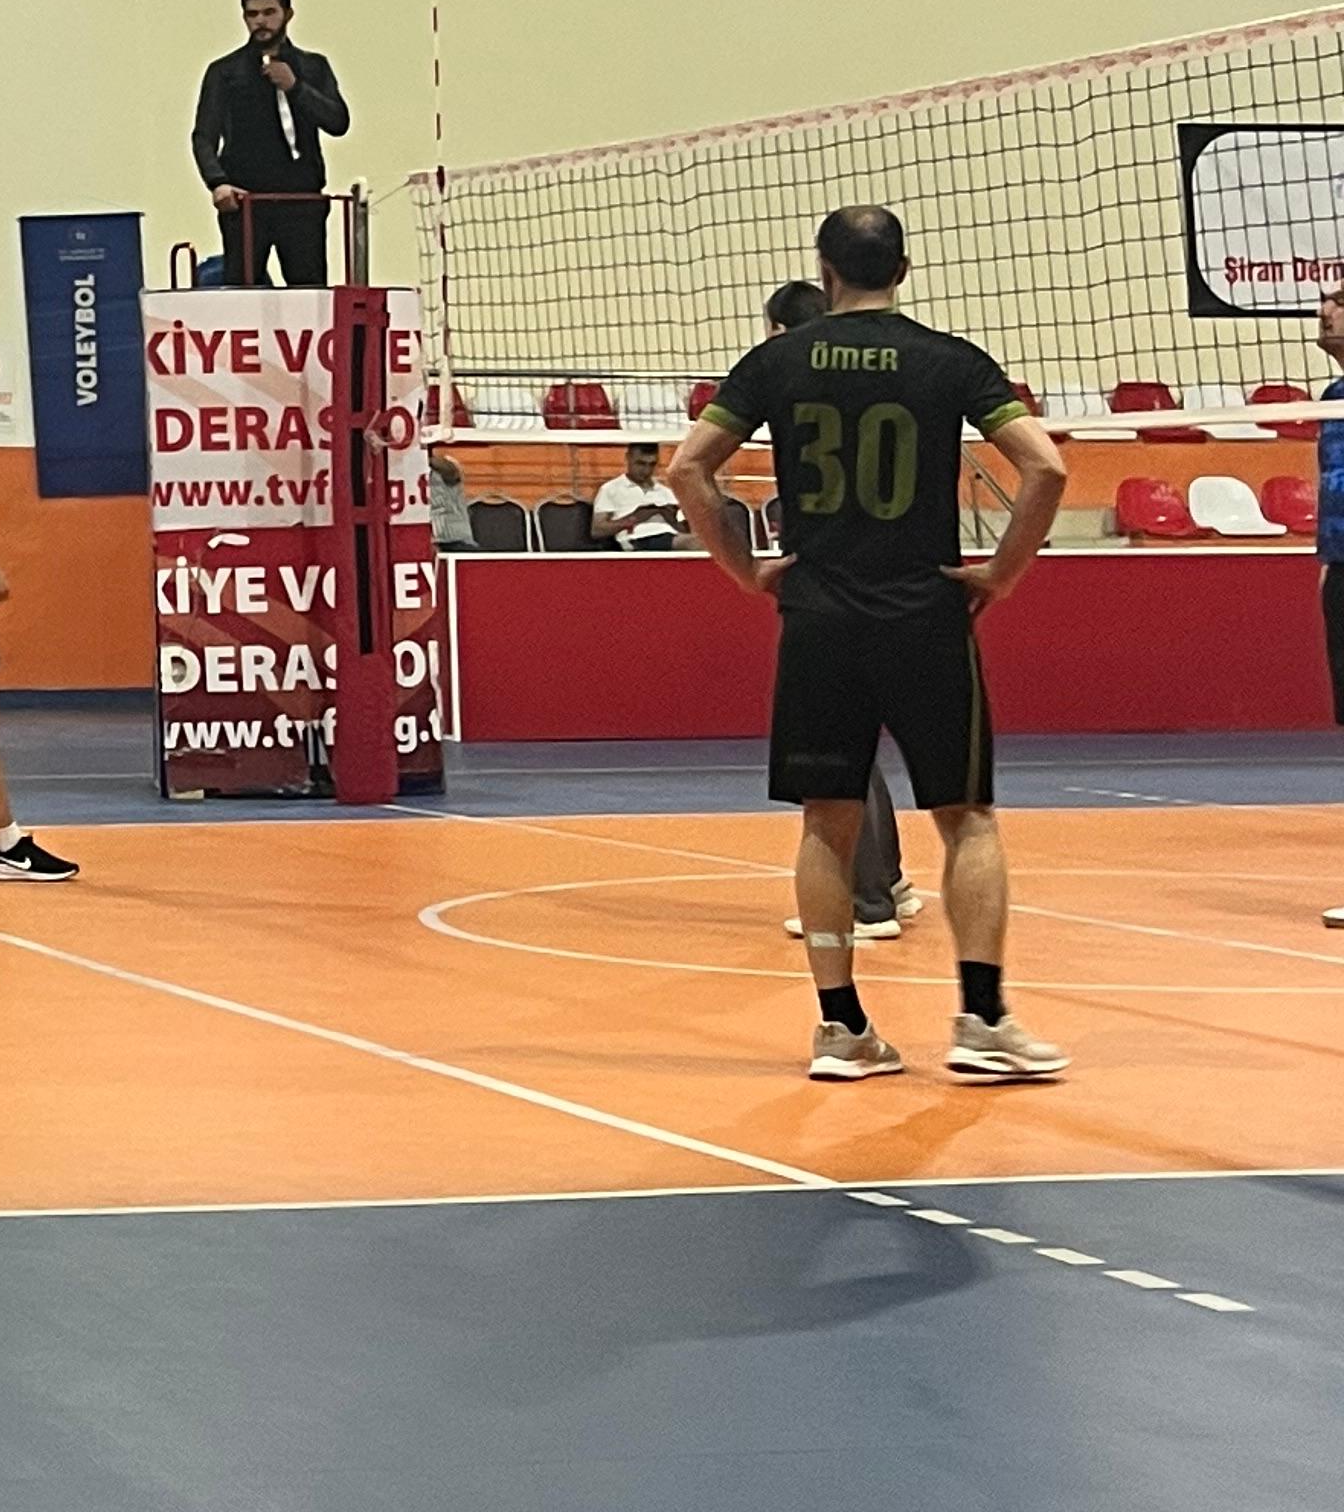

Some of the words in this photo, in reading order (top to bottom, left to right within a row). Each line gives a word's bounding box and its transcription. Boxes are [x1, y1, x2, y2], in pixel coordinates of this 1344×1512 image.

[74, 274, 98, 417] VOLEYBOL
[811, 341, 899, 371] ÖMER
[155, 406, 415, 453] DERAO
[793, 401, 919, 521] 30
